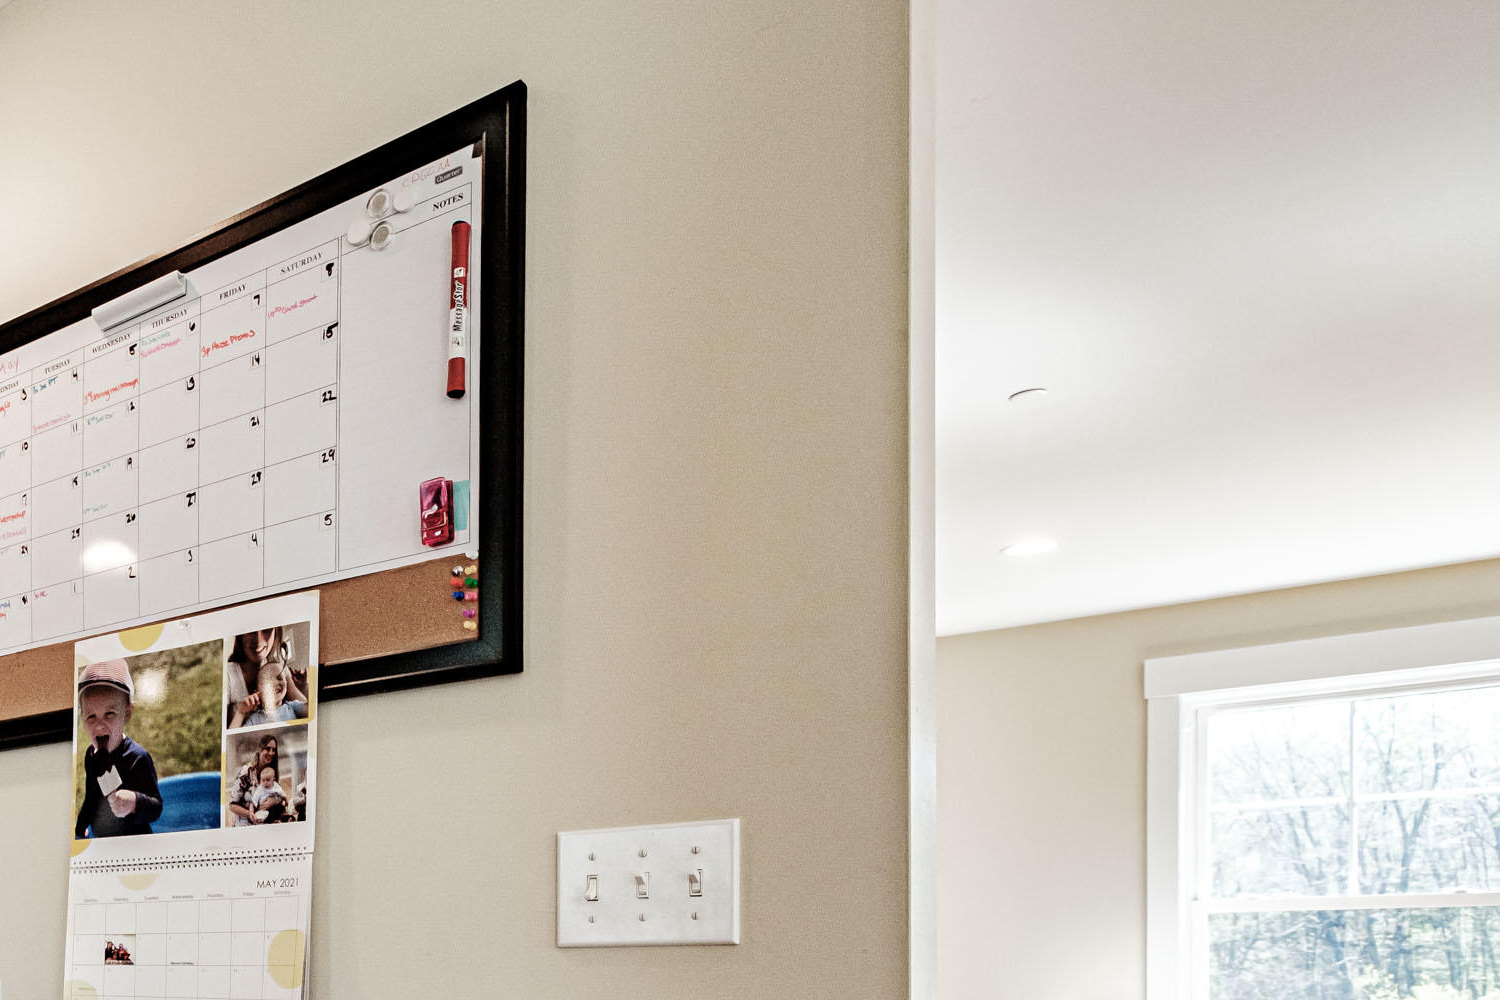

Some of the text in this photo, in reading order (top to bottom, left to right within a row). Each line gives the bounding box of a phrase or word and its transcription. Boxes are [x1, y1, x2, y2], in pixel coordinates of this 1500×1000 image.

[432, 192, 464, 211] NOTES
[280, 252, 322, 274] SATURDAY
[220, 284, 247, 300] FRIDAY
[253, 294, 260, 306] 7
[152, 308, 189, 328] THURSDAY
[322, 322, 339, 340] 15
[92, 332, 132, 354] WEDNESDAY
[128, 343, 138, 356] 5
[252, 352, 260, 366] 14
[44, 359, 70, 375] TUESDAY
[72, 368, 78, 381] 4
[322, 390, 337, 404] 22
[250, 415, 260, 427] 21
[22, 442, 28, 452] 10
[322, 448, 336, 464] 29
[186, 491, 196, 508] 27
[126, 512, 136, 524] 26
[324, 514, 332, 526] 5
[252, 532, 258, 546] 4
[128, 566, 136, 578] 2
[256, 878, 300, 889] MAY 2021
